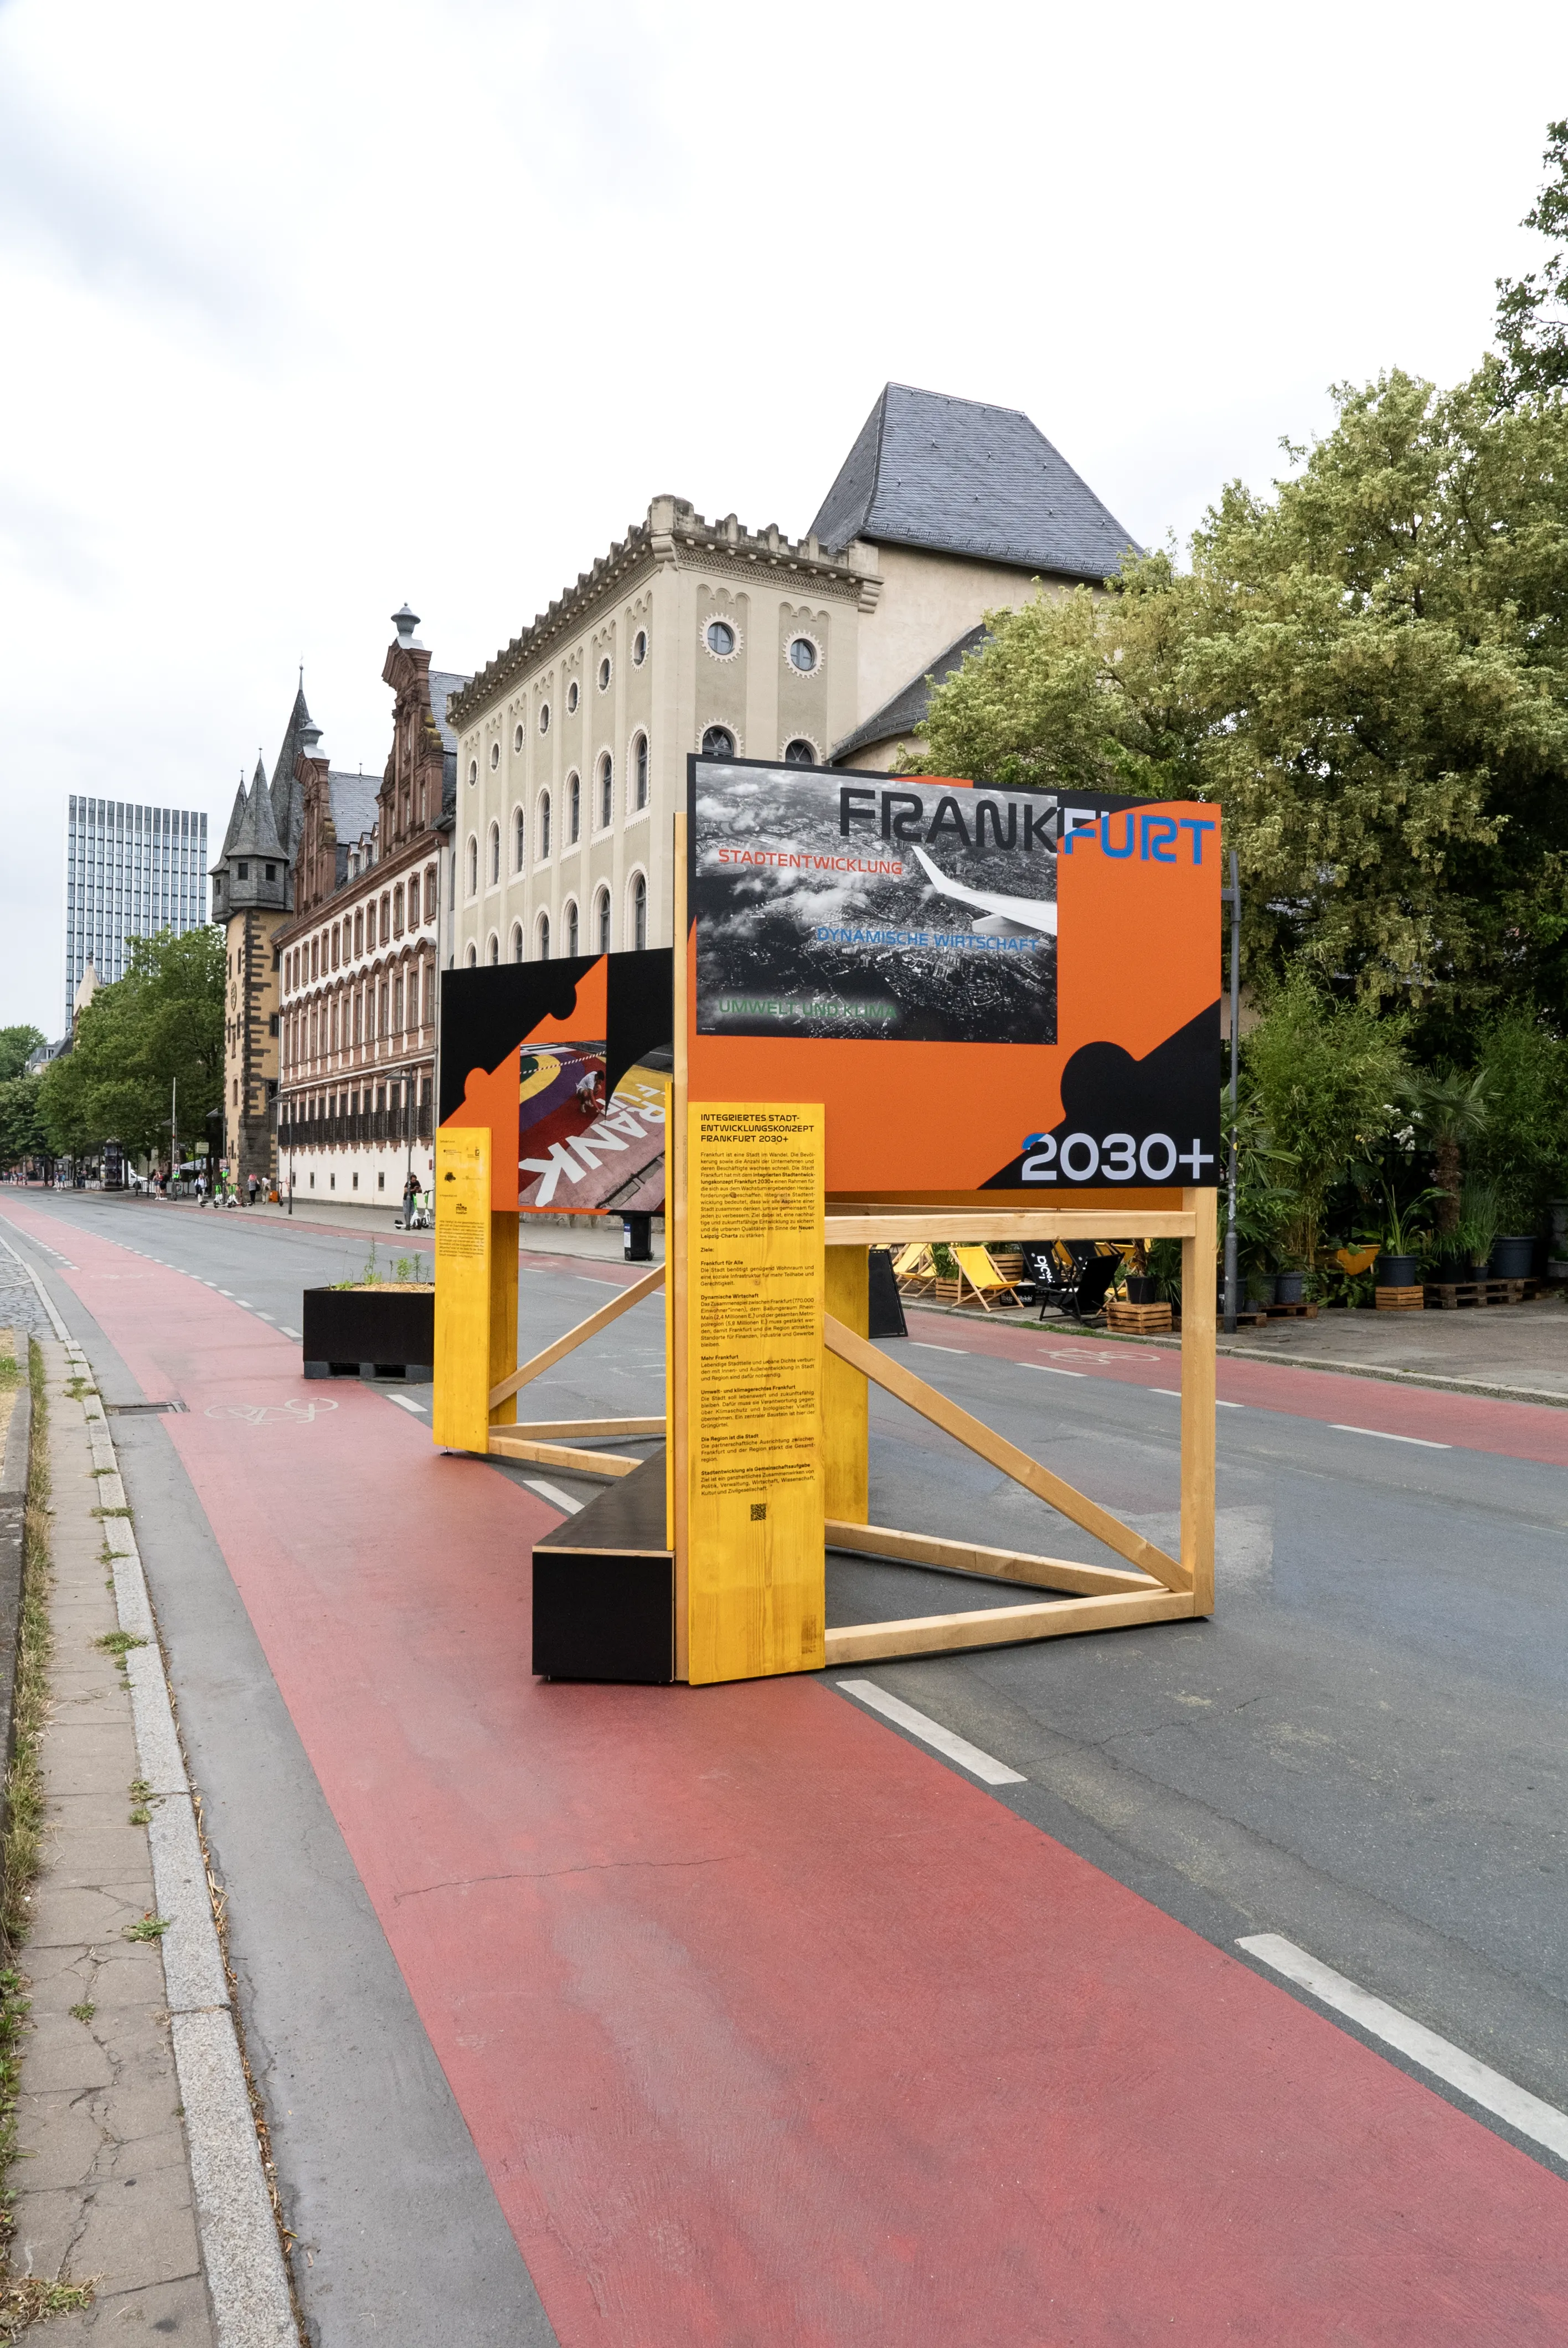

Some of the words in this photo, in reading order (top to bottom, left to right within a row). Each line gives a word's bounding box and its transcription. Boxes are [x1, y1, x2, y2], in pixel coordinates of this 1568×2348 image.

[840, 787, 1215, 865] FRANKFURT
[719, 849, 902, 875] STADTENTWICKLUNG
[817, 928, 928, 946] DYNAMISCHE
[935, 935, 1039, 952] WIRTSCHAFT
[720, 1000, 796, 1015] UMWELT
[803, 1003, 838, 1016] UND
[844, 1003, 897, 1018] KLIMA
[1022, 1132, 1214, 1181] 2030+
